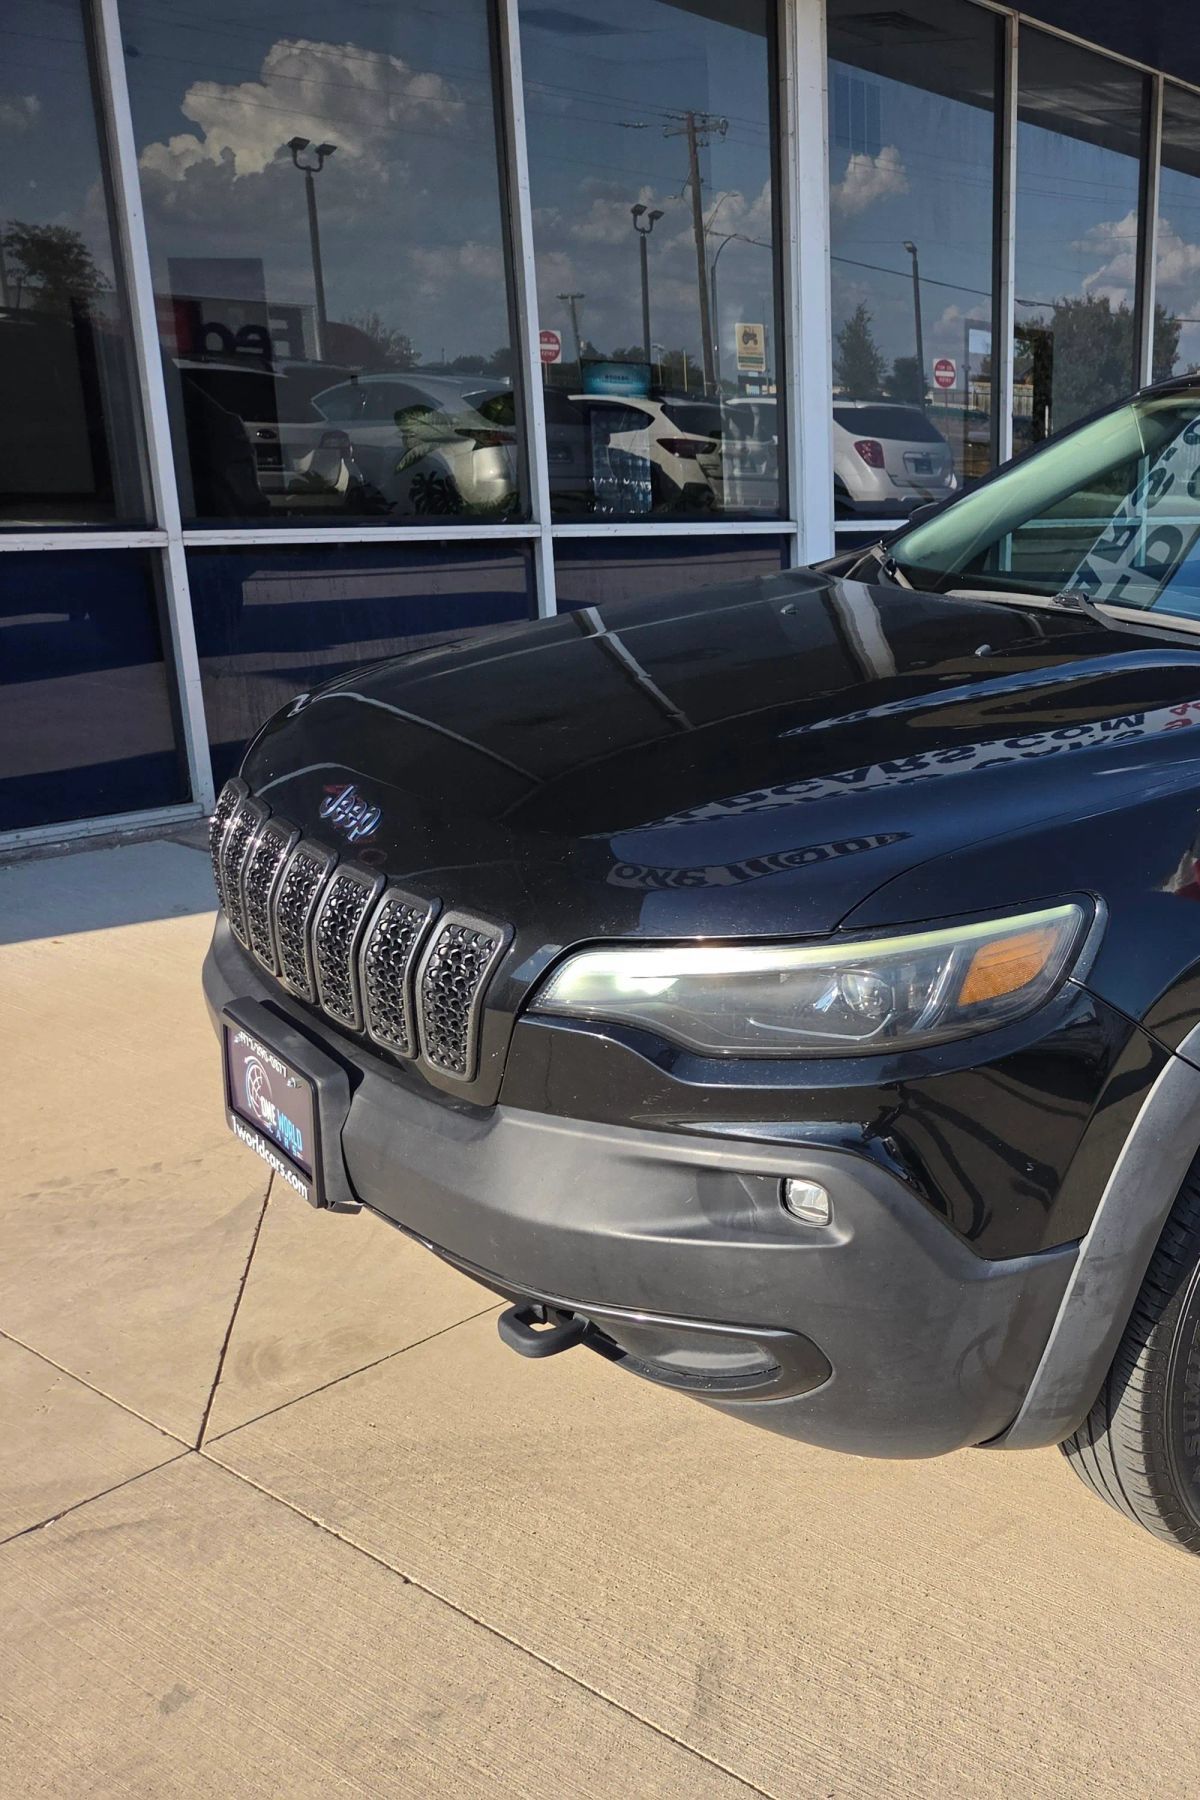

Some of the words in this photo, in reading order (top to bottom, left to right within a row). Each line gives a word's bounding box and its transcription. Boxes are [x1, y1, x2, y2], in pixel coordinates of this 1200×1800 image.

[319, 784, 382, 842] Jeep
[260, 1095, 277, 1126] ONE
[277, 1108, 303, 1152] WORLD
[231, 1115, 309, 1200] 1worldcars.com
